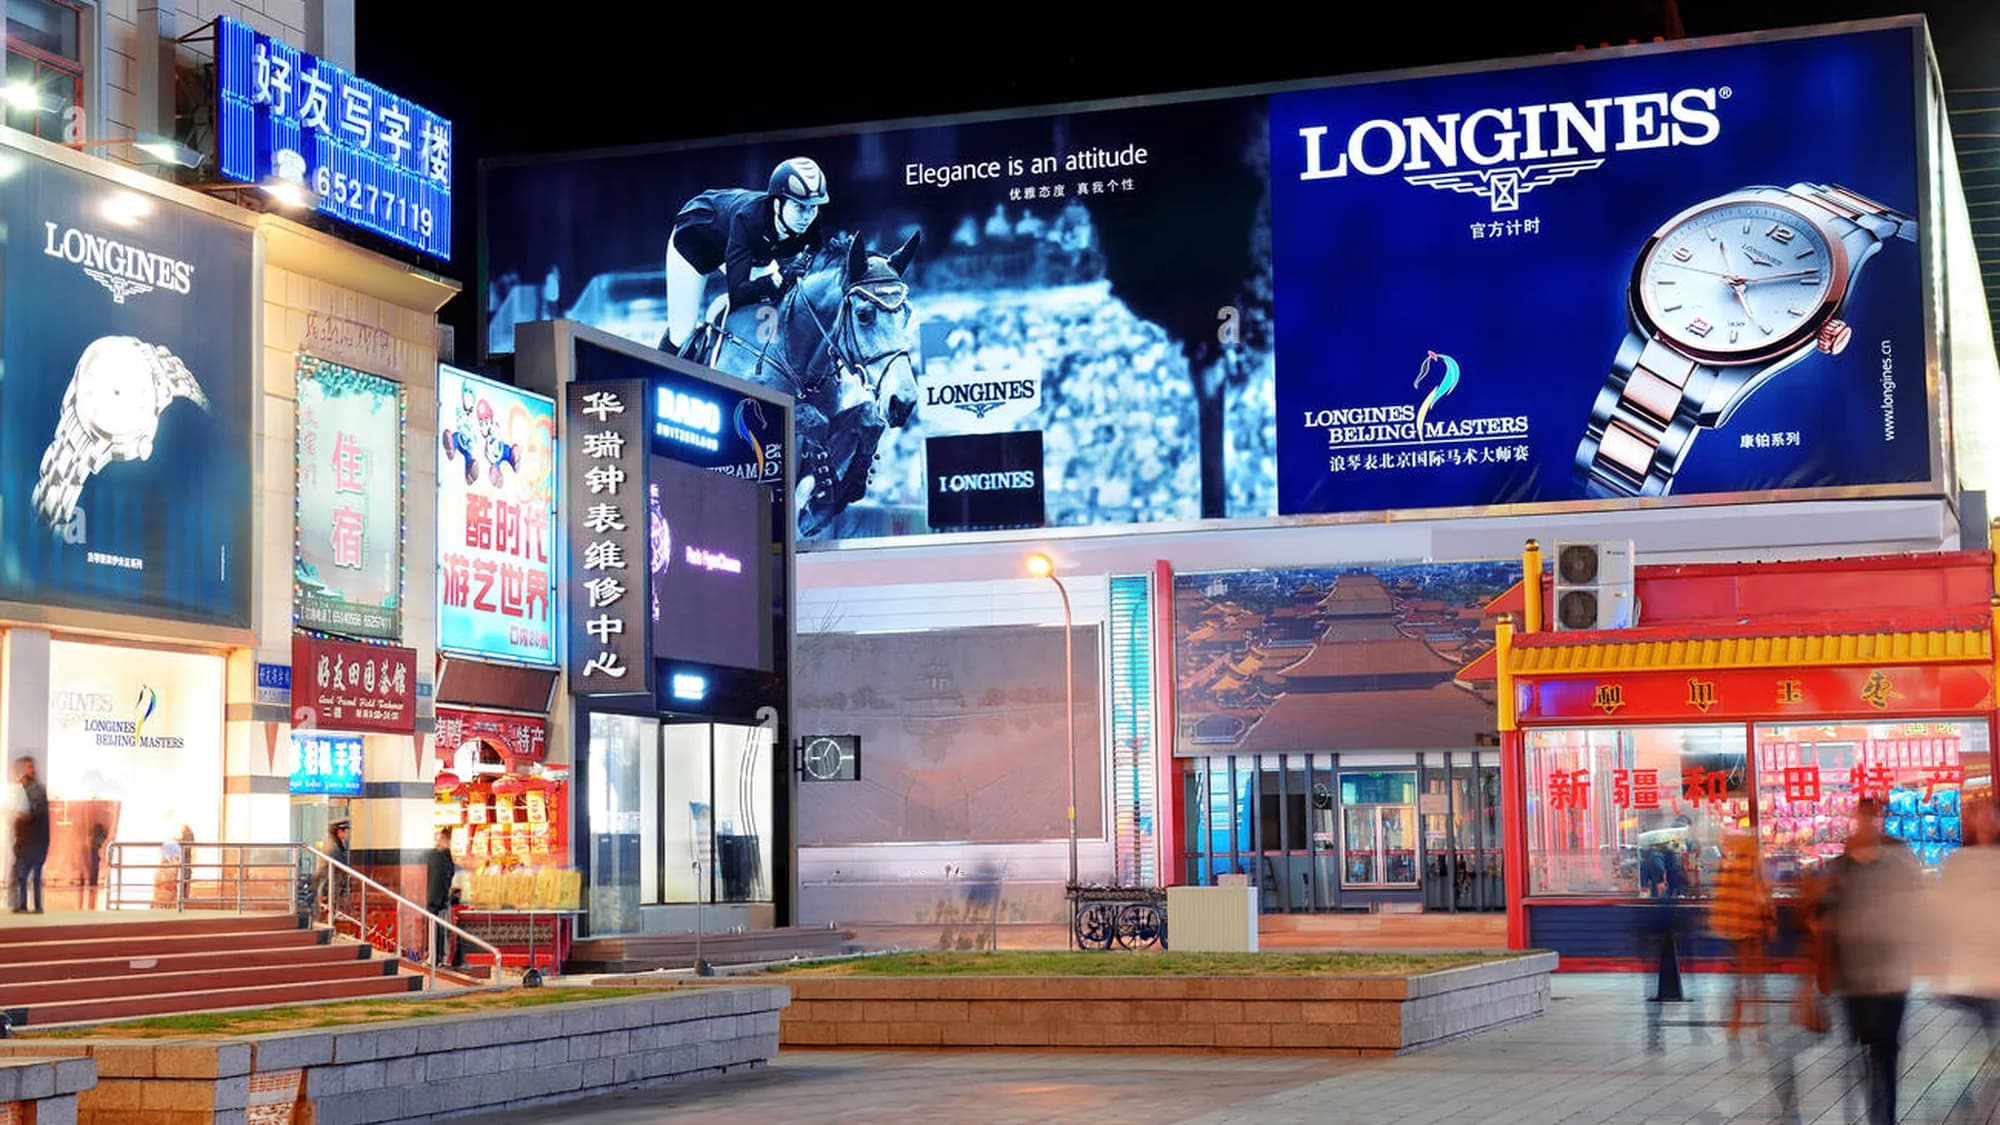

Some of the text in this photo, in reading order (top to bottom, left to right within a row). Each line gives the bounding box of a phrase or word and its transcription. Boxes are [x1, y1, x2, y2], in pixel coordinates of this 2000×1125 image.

[251, 43, 449, 184] 好友写字楼
[1300, 87, 1720, 180] LONGINES
[906, 143, 1148, 188] Elegance is an attitude
[1009, 177, 1135, 201] 优雅态度 真我个性
[314, 165, 433, 237] 65277119
[1470, 218, 1541, 239] 官方计时
[44, 220, 191, 294] LONGINES
[927, 380, 1035, 406] LONGINES
[1880, 339, 1897, 442] www.longines.cn
[1304, 405, 1415, 427] LONGINES
[1328, 415, 1529, 445] BEIJING MASTERS
[1740, 430, 1801, 449] 康铂系列
[1329, 444, 1529, 473] 浪琴表北京国际马术大师赛
[332, 431, 364, 571] 住宿
[465, 493, 548, 563] 酷时代
[581, 391, 628, 678] 华瑞钟表维修中心
[443, 552, 549, 622] 游艺世界
[84, 719, 137, 734] LONGINES
[96, 733, 184, 749] BEIJING MASTERS
[1548, 762, 1965, 811] 新疆和田特产
